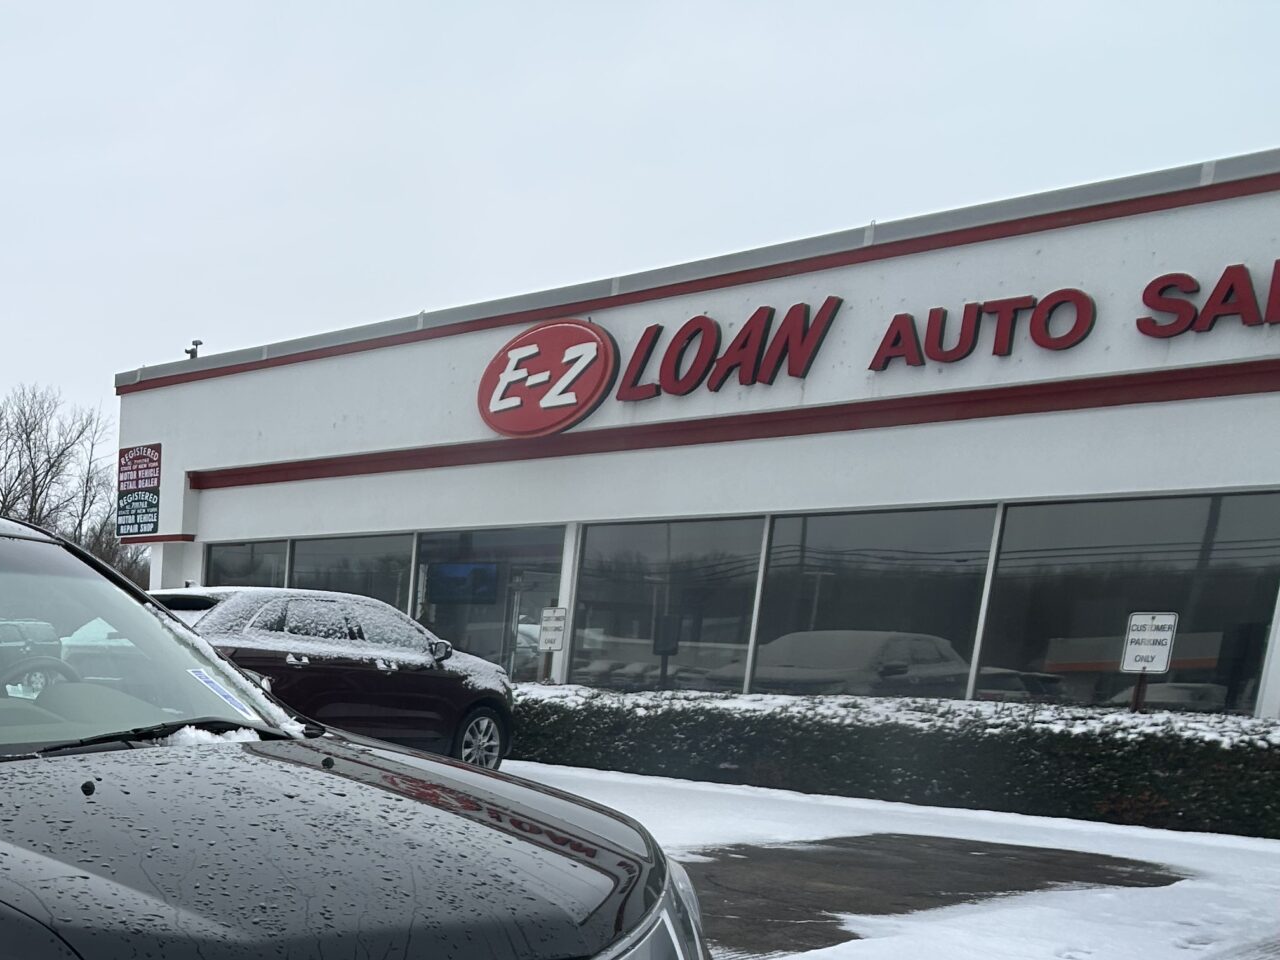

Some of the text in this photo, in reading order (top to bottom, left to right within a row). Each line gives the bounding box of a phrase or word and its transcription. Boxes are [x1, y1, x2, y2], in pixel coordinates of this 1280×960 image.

[488, 339, 600, 414] E-Z
[615, 295, 844, 402] LOAN
[868, 286, 1097, 372] AUTO
[120, 447, 159, 465] REGISTERED
[119, 467, 160, 481] MOTOR VEHICLE
[120, 477, 158, 491] RETAIL DEALER
[119, 492, 158, 508] REGISTERED
[118, 513, 158, 525] MOTOR VEHICLE
[120, 523, 154, 534] REPAIR SHOP
[1130, 624, 1173, 632] CUSTOMER
[1130, 638, 1168, 646] PARKING
[1134, 654, 1156, 663] ONLY
